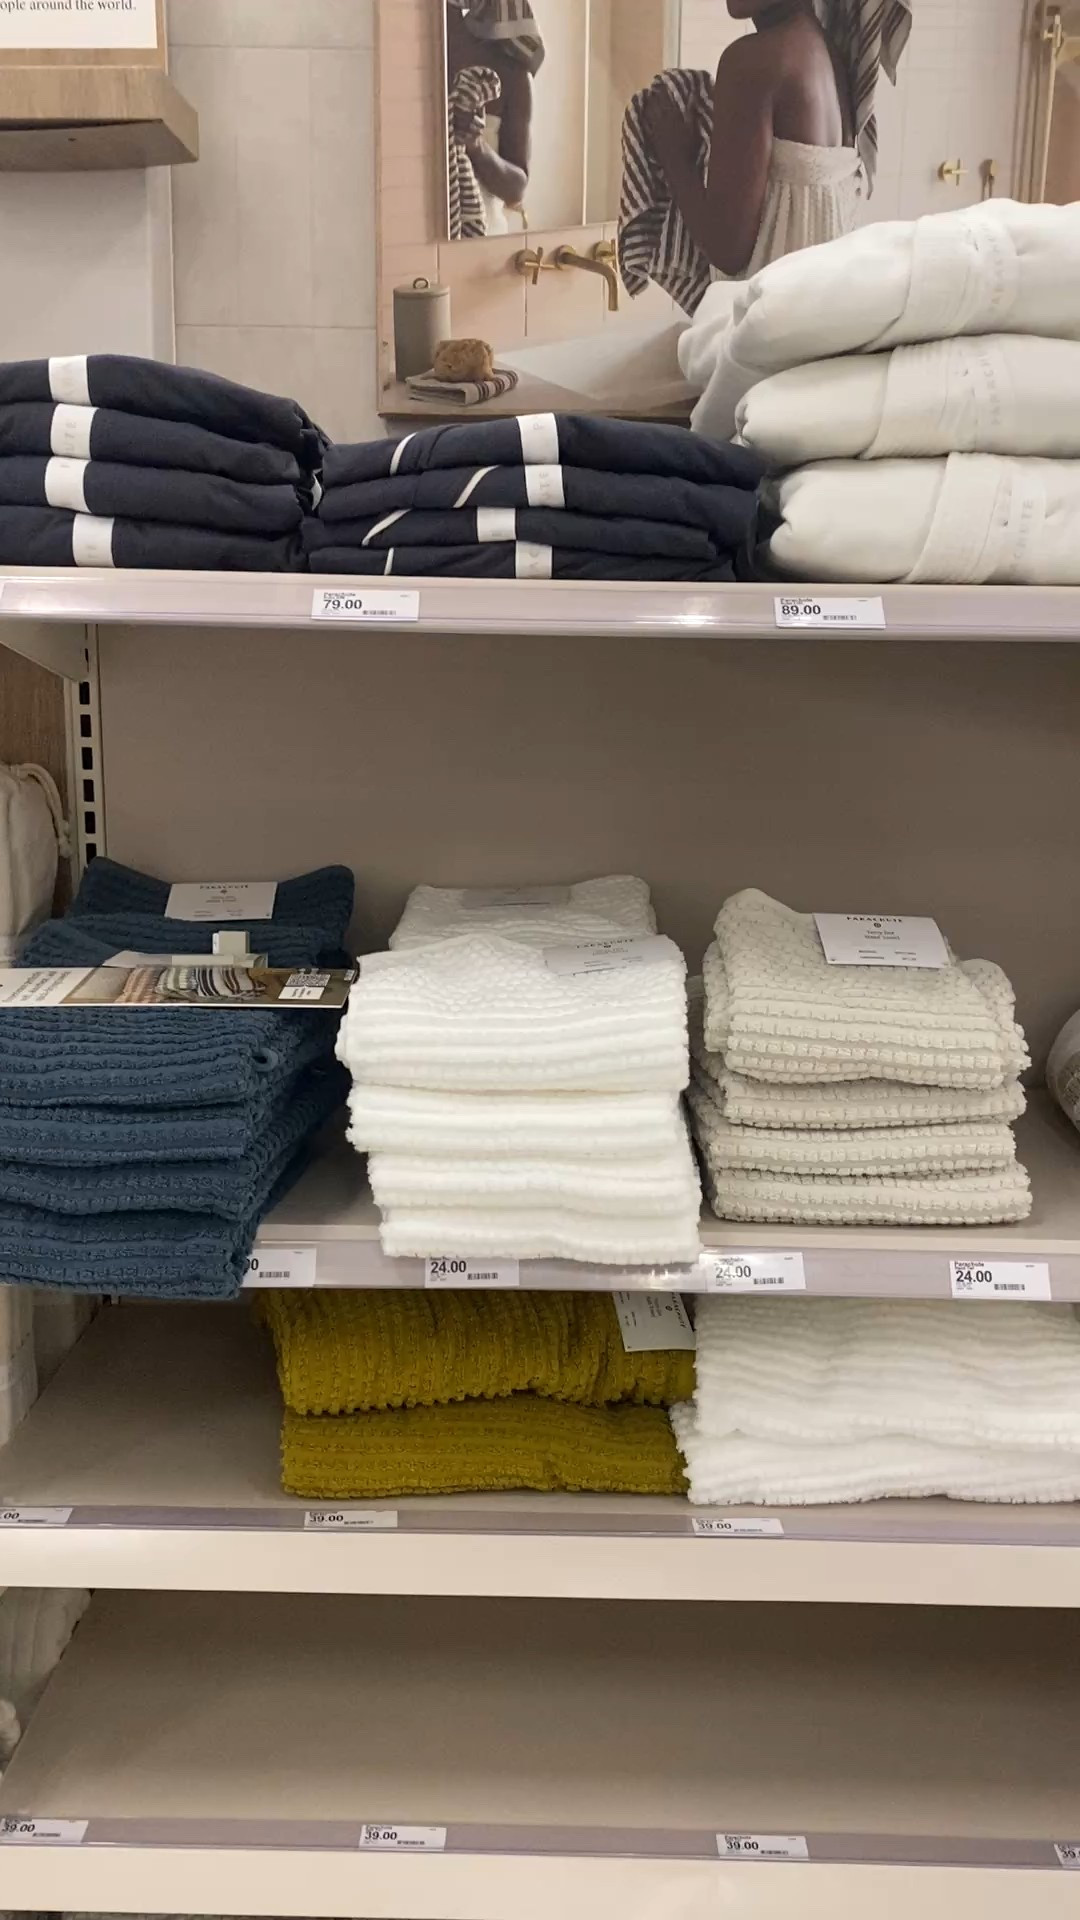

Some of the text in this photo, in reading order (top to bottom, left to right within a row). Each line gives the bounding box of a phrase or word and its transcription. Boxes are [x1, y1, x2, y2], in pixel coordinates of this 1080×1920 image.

[0, 0, 137, 13] ople around the world.
[323, 599, 363, 610] 79.00
[781, 604, 821, 615] 89.00
[430, 1260, 467, 1274] 24.00
[715, 1265, 752, 1279] 24.00
[955, 1270, 993, 1283] 24.00
[2, 1823, 36, 1833] 39.00
[364, 1831, 398, 1841] 39.00
[726, 1841, 759, 1851] 39.00
